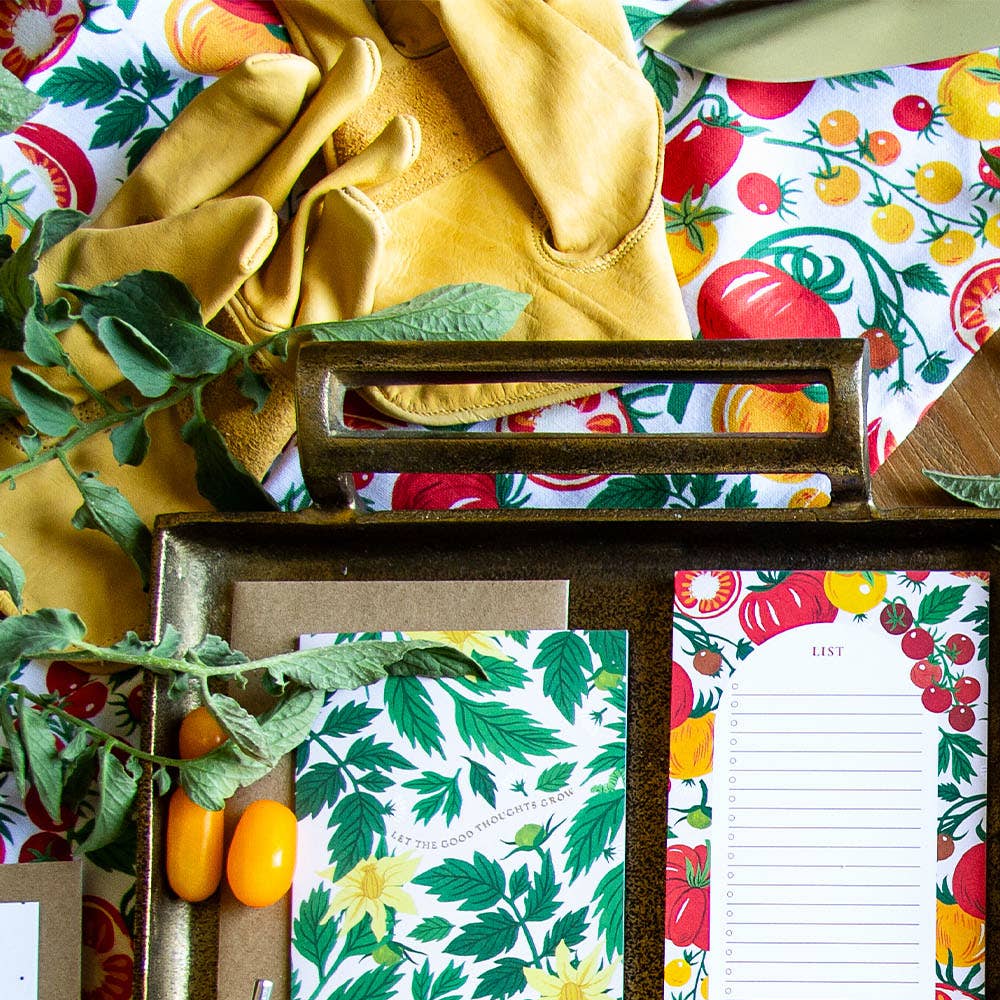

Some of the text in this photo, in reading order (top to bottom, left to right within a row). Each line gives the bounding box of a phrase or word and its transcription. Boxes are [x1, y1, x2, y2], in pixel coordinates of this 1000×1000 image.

[812, 646, 844, 656] LIST
[390, 787, 575, 850] LET THE GOOD THOUGHTS GROW
